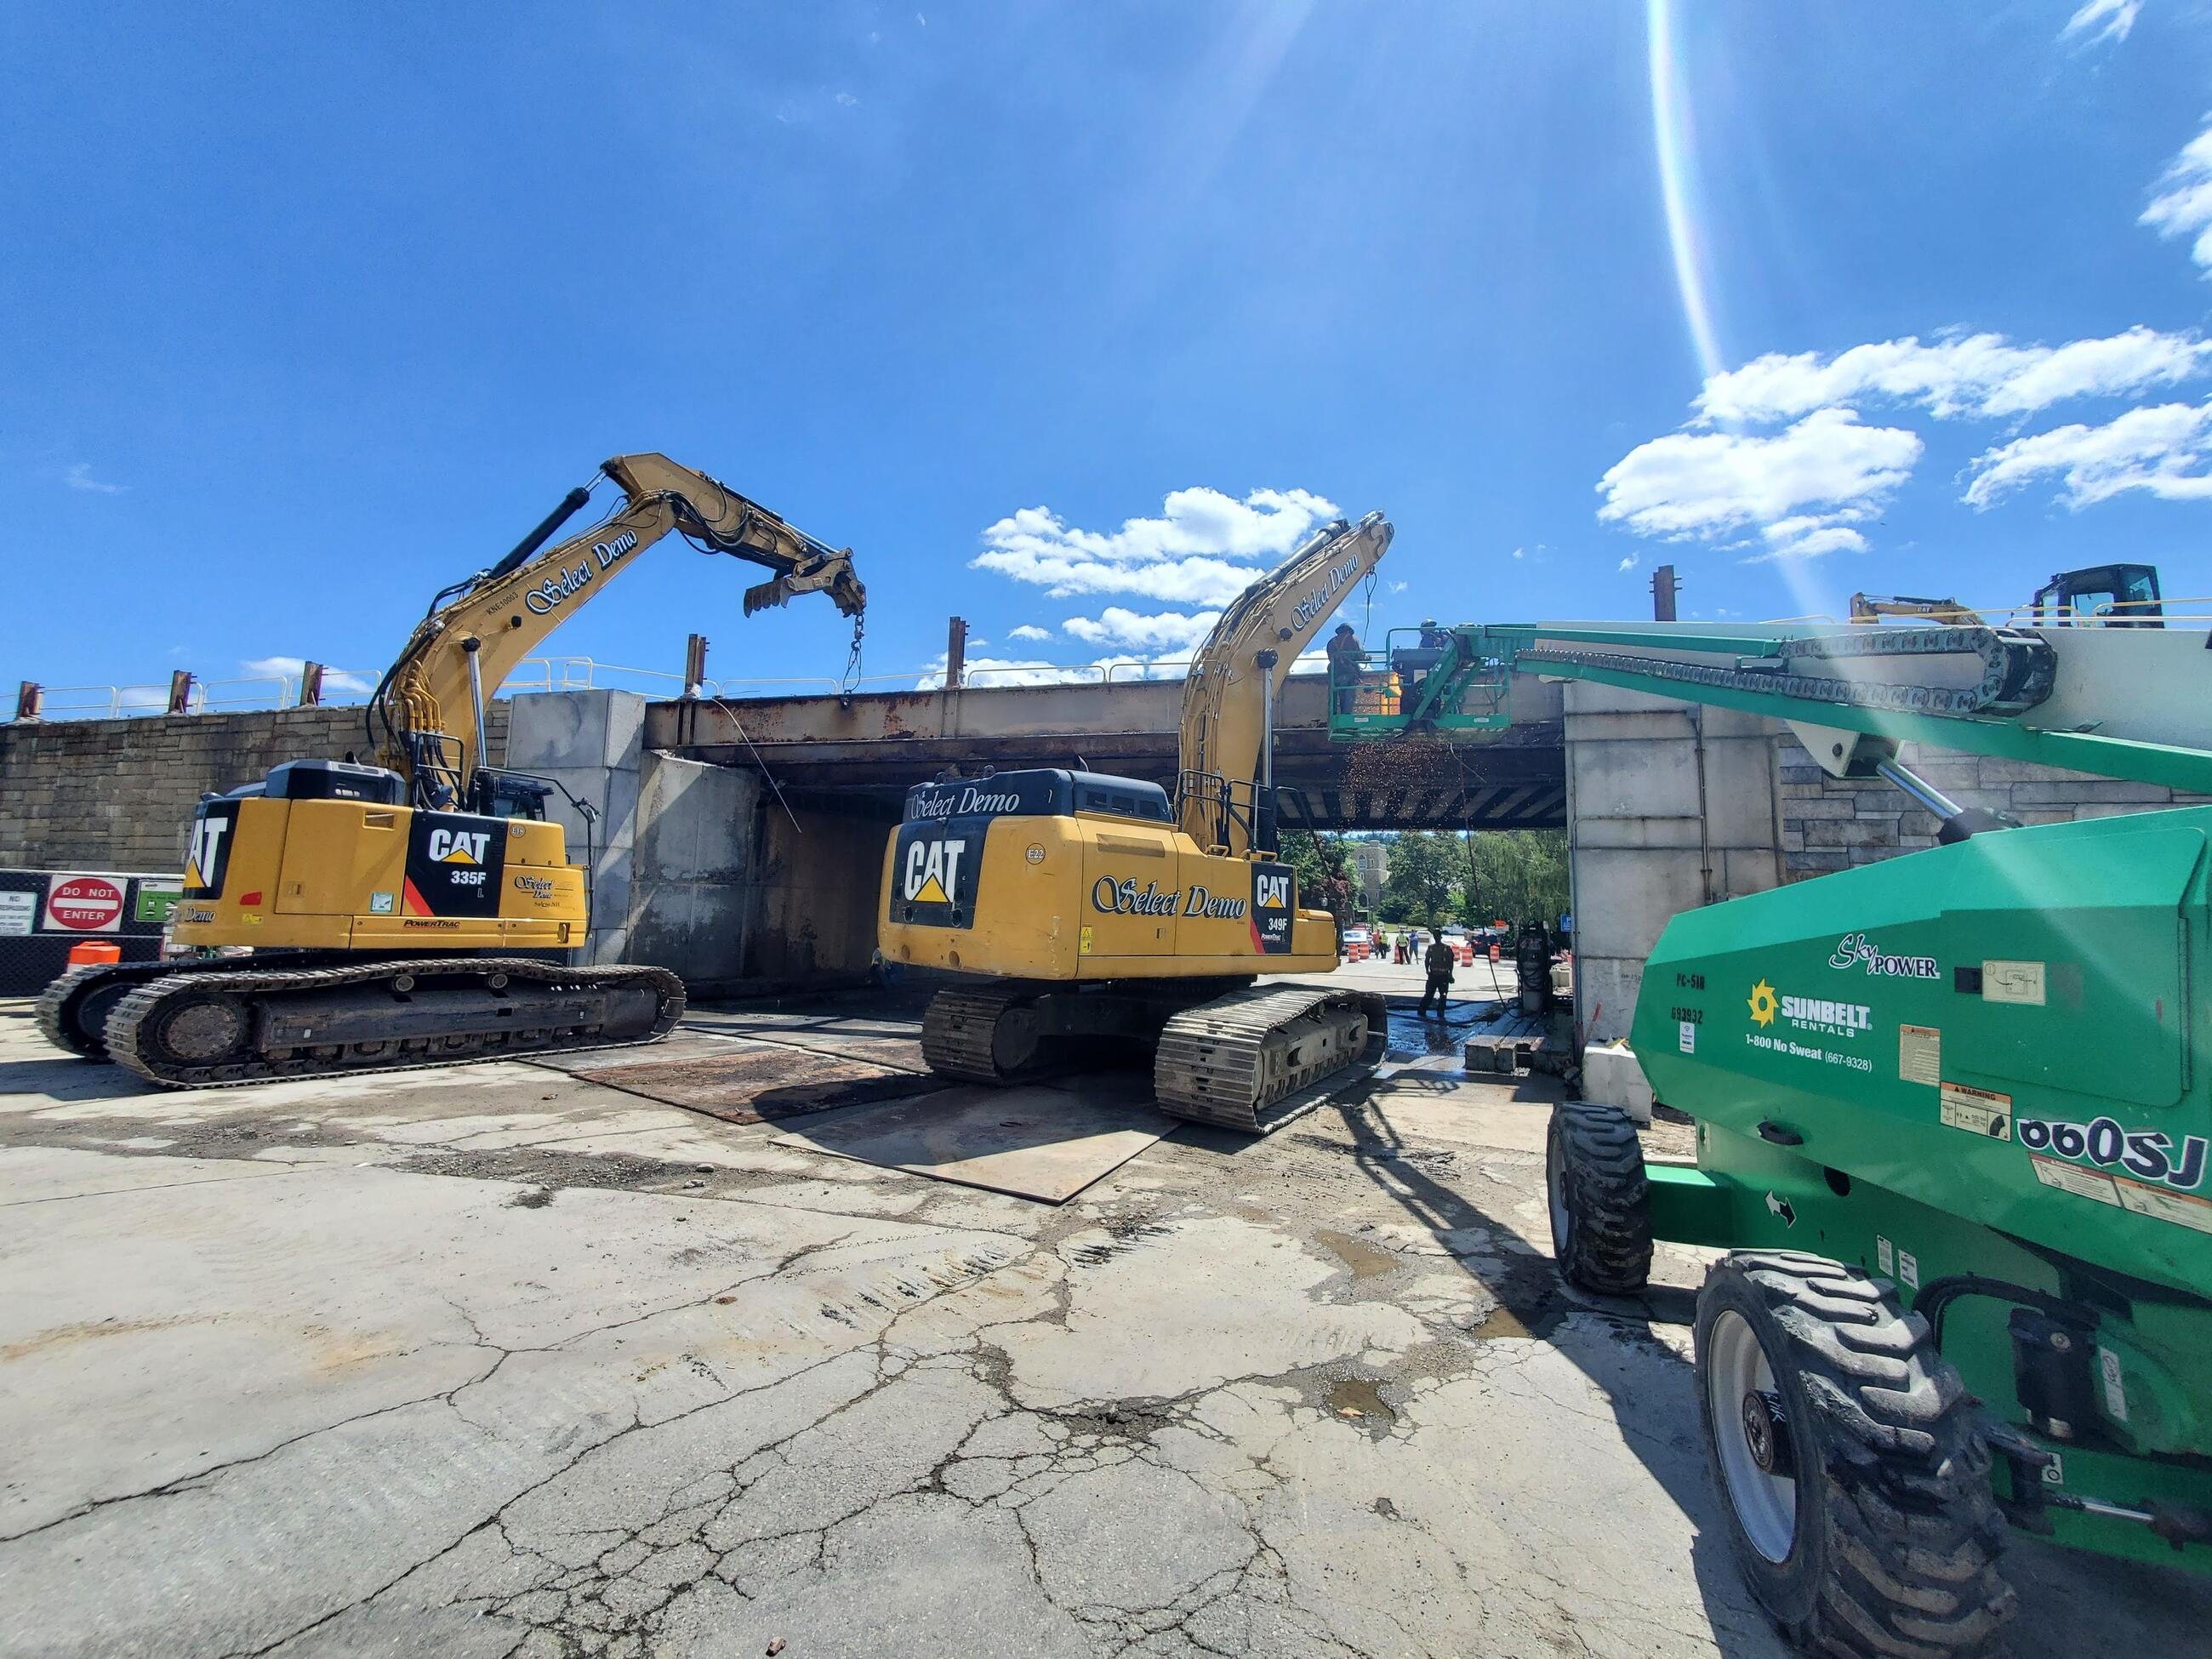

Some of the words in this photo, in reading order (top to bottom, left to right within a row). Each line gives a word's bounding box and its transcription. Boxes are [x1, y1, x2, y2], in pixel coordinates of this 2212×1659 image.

[525, 559, 593, 615] Select
[592, 529, 639, 571] Demo
[1291, 582, 1330, 632] Select
[1328, 553, 1359, 596] Demo
[910, 790, 955, 819] Select
[956, 787, 1020, 814] Demo
[187, 817, 229, 888] AT
[429, 829, 491, 864] CAT
[1027, 849, 1044, 858] E22
[450, 869, 487, 885] 335F
[904, 840, 966, 903] CAT
[62, 887, 81, 896] DO
[88, 887, 114, 898] NOT
[1092, 875, 1182, 916] Select
[1182, 885, 1246, 920] Demo
[1257, 875, 1289, 908] CAT
[62, 910, 105, 921] ENTER
[185, 907, 216, 923] Demo
[1268, 917, 1288, 931] 349F
[1782, 995, 1871, 1030] SUNBELT
[1791, 1018, 1855, 1037] RENTALS
[1745, 1034, 1771, 1048] 1-800
[1773, 1038, 1787, 1052] No
[1789, 1042, 1822, 1060] Sweat
[1824, 1050, 1873, 1073] (667-9328)
[1961, 1086, 1996, 1101] WARNING
